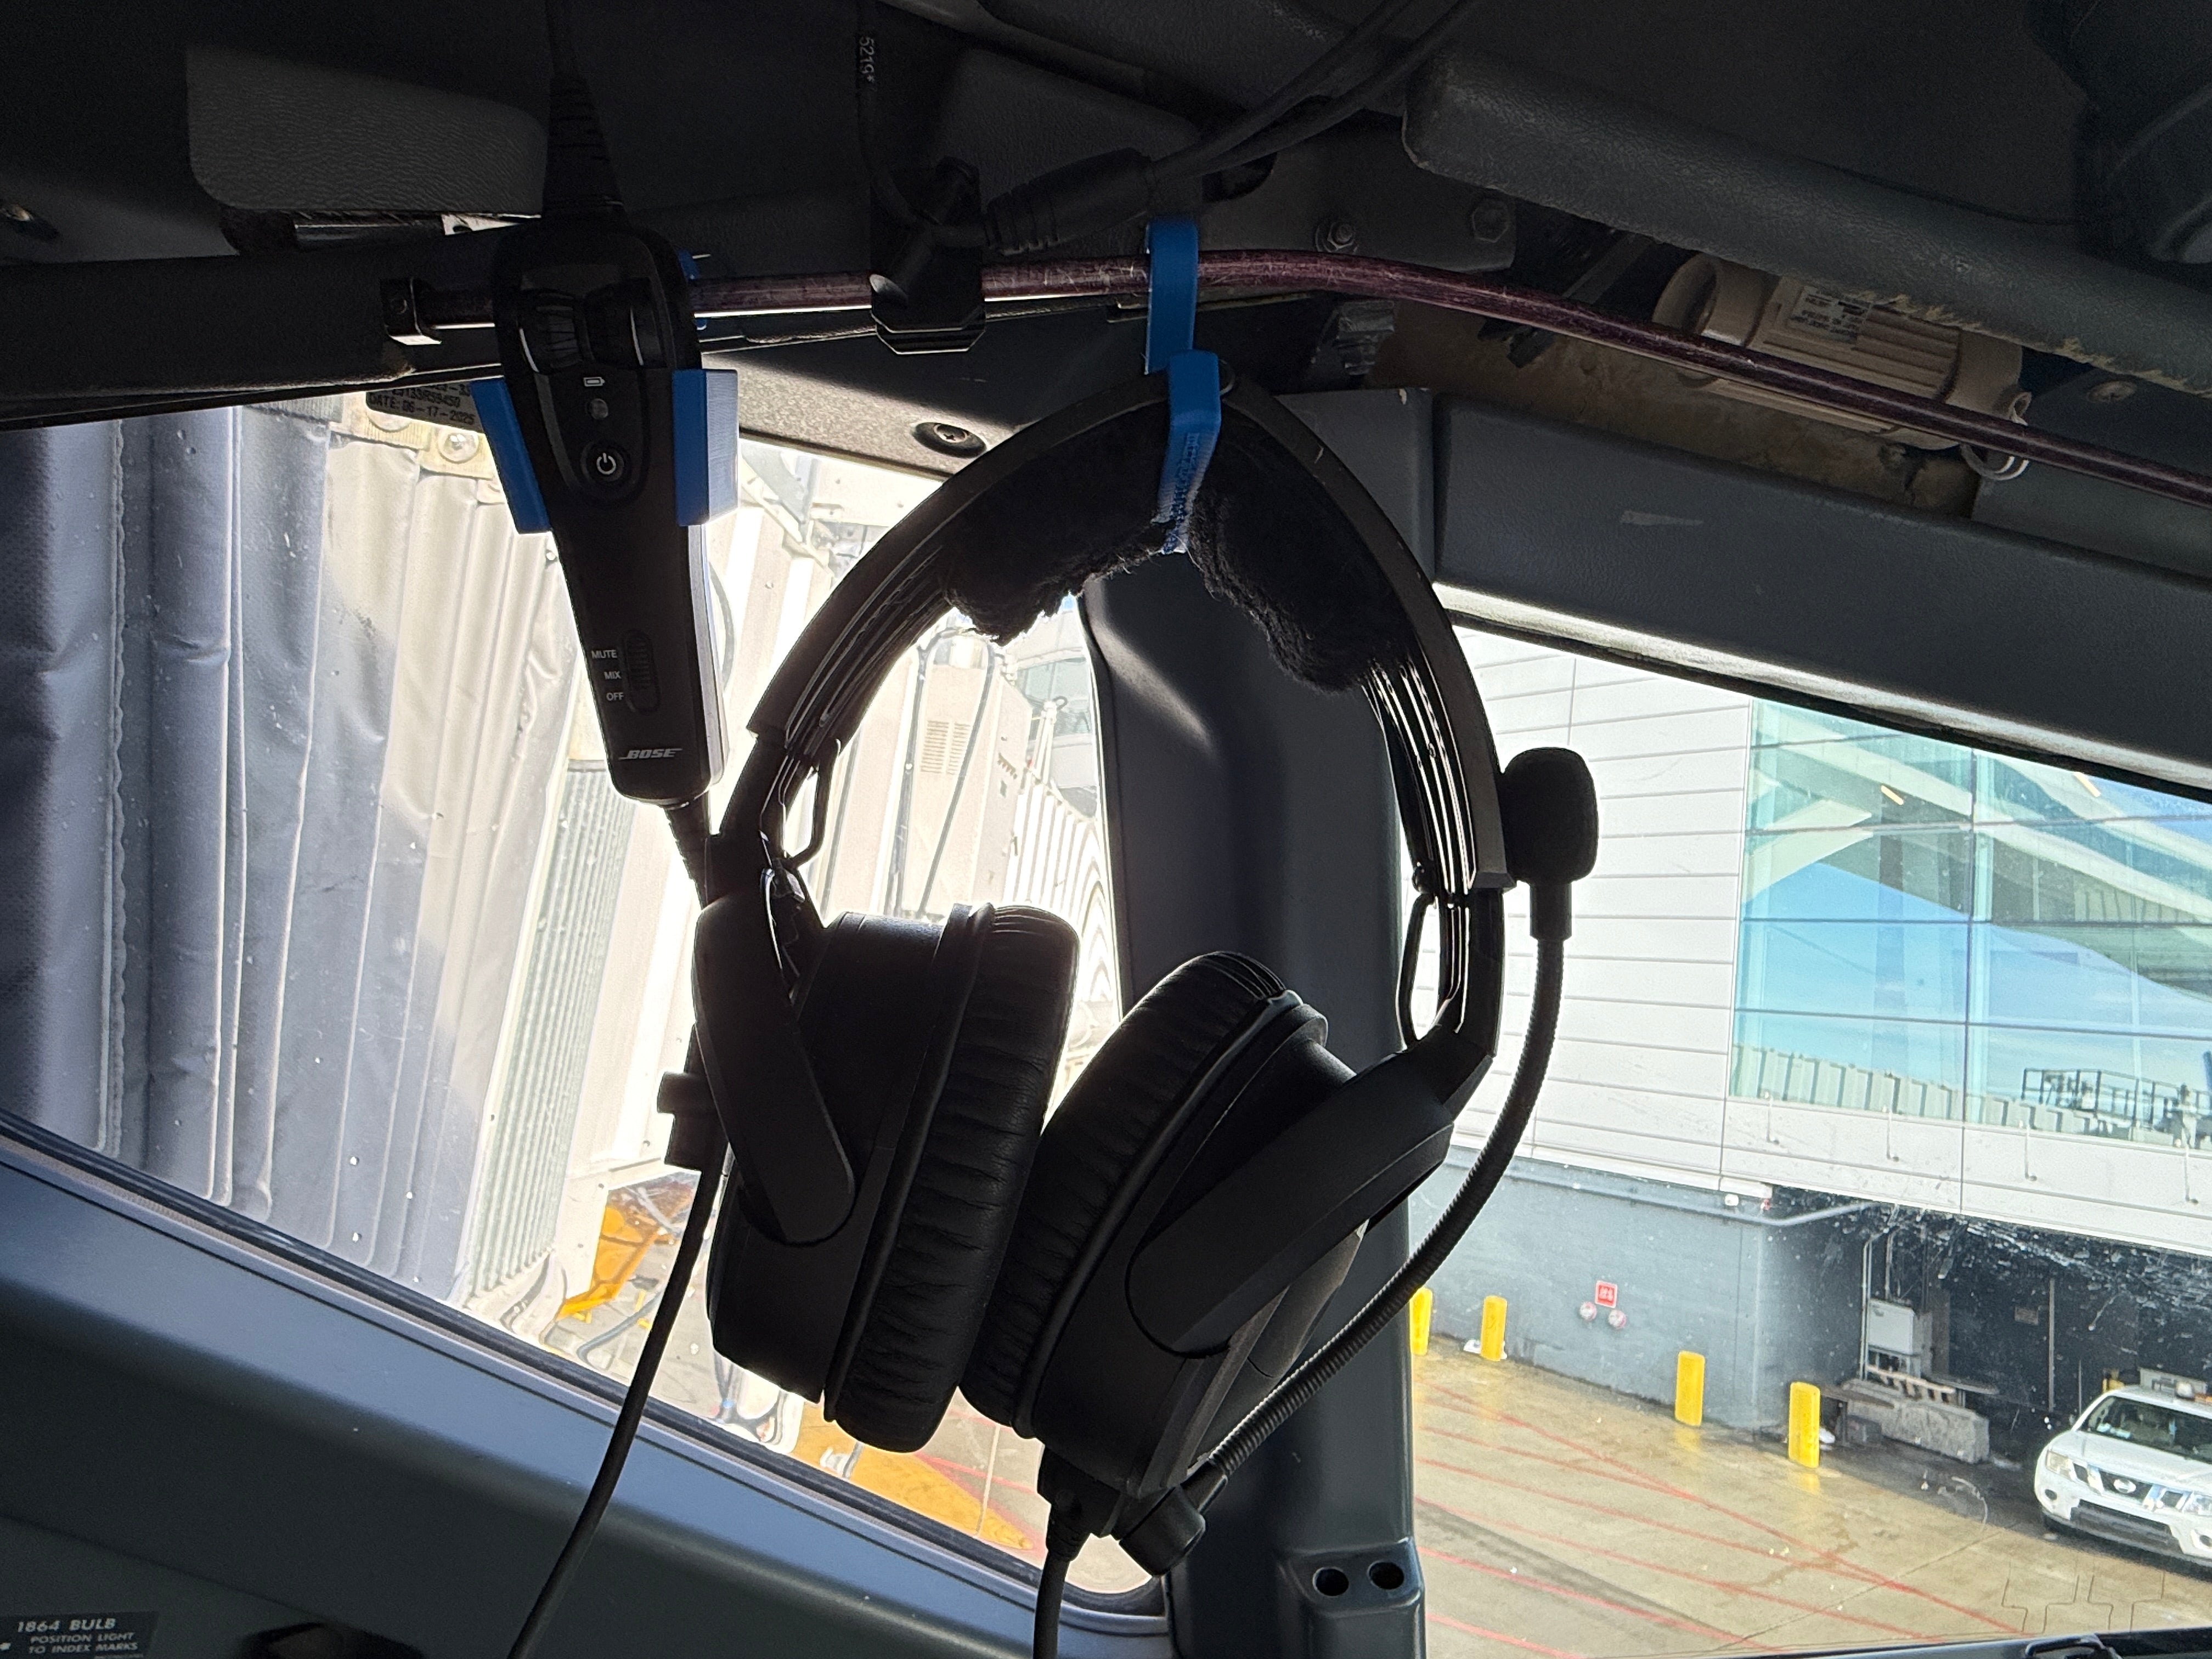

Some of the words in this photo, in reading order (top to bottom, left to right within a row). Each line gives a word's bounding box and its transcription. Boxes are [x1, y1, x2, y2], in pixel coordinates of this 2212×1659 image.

[591, 650, 618, 658] MUTE
[604, 671, 622, 680] MIX
[606, 692, 624, 701] OFF
[619, 747, 682, 760] BOSE
[18, 1620, 61, 1633] 1864
[69, 1618, 117, 1631] BULB
[30, 1634, 92, 1644] POSITION
[98, 1632, 136, 1641] LIGHT
[28, 1646, 46, 1654] TO
[51, 1644, 92, 1654] INDEX
[95, 1642, 138, 1652] MARKS
